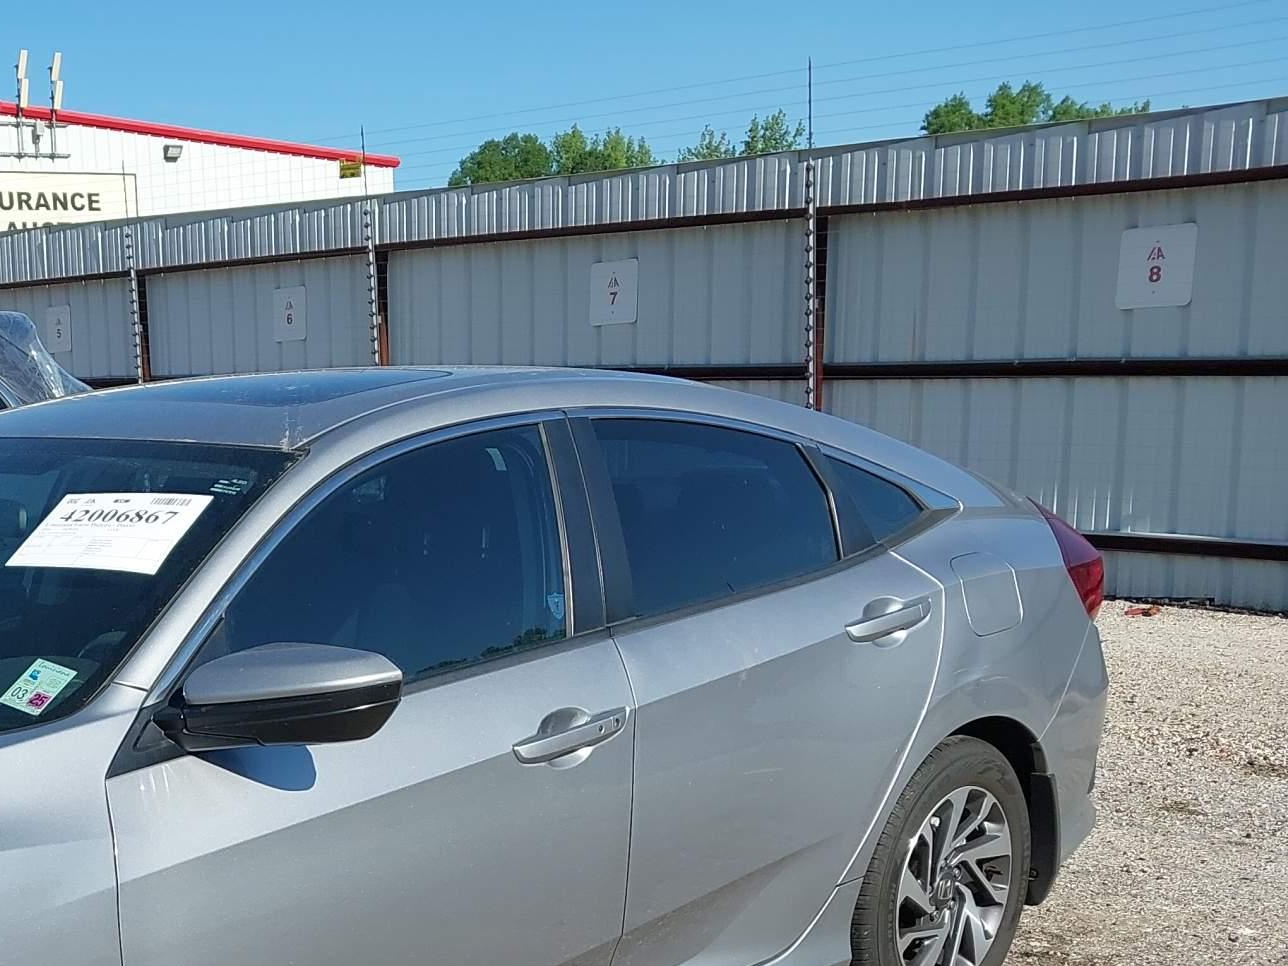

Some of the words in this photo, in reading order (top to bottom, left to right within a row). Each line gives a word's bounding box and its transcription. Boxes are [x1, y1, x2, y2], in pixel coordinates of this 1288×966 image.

[1148, 265, 1162, 283] 8
[609, 291, 618, 305] 7
[286, 313, 293, 325] 6
[56, 327, 62, 339] 5
[60, 508, 179, 525] 42006867
[11, 686, 29, 700] 03
[29, 693, 49, 707] 25
